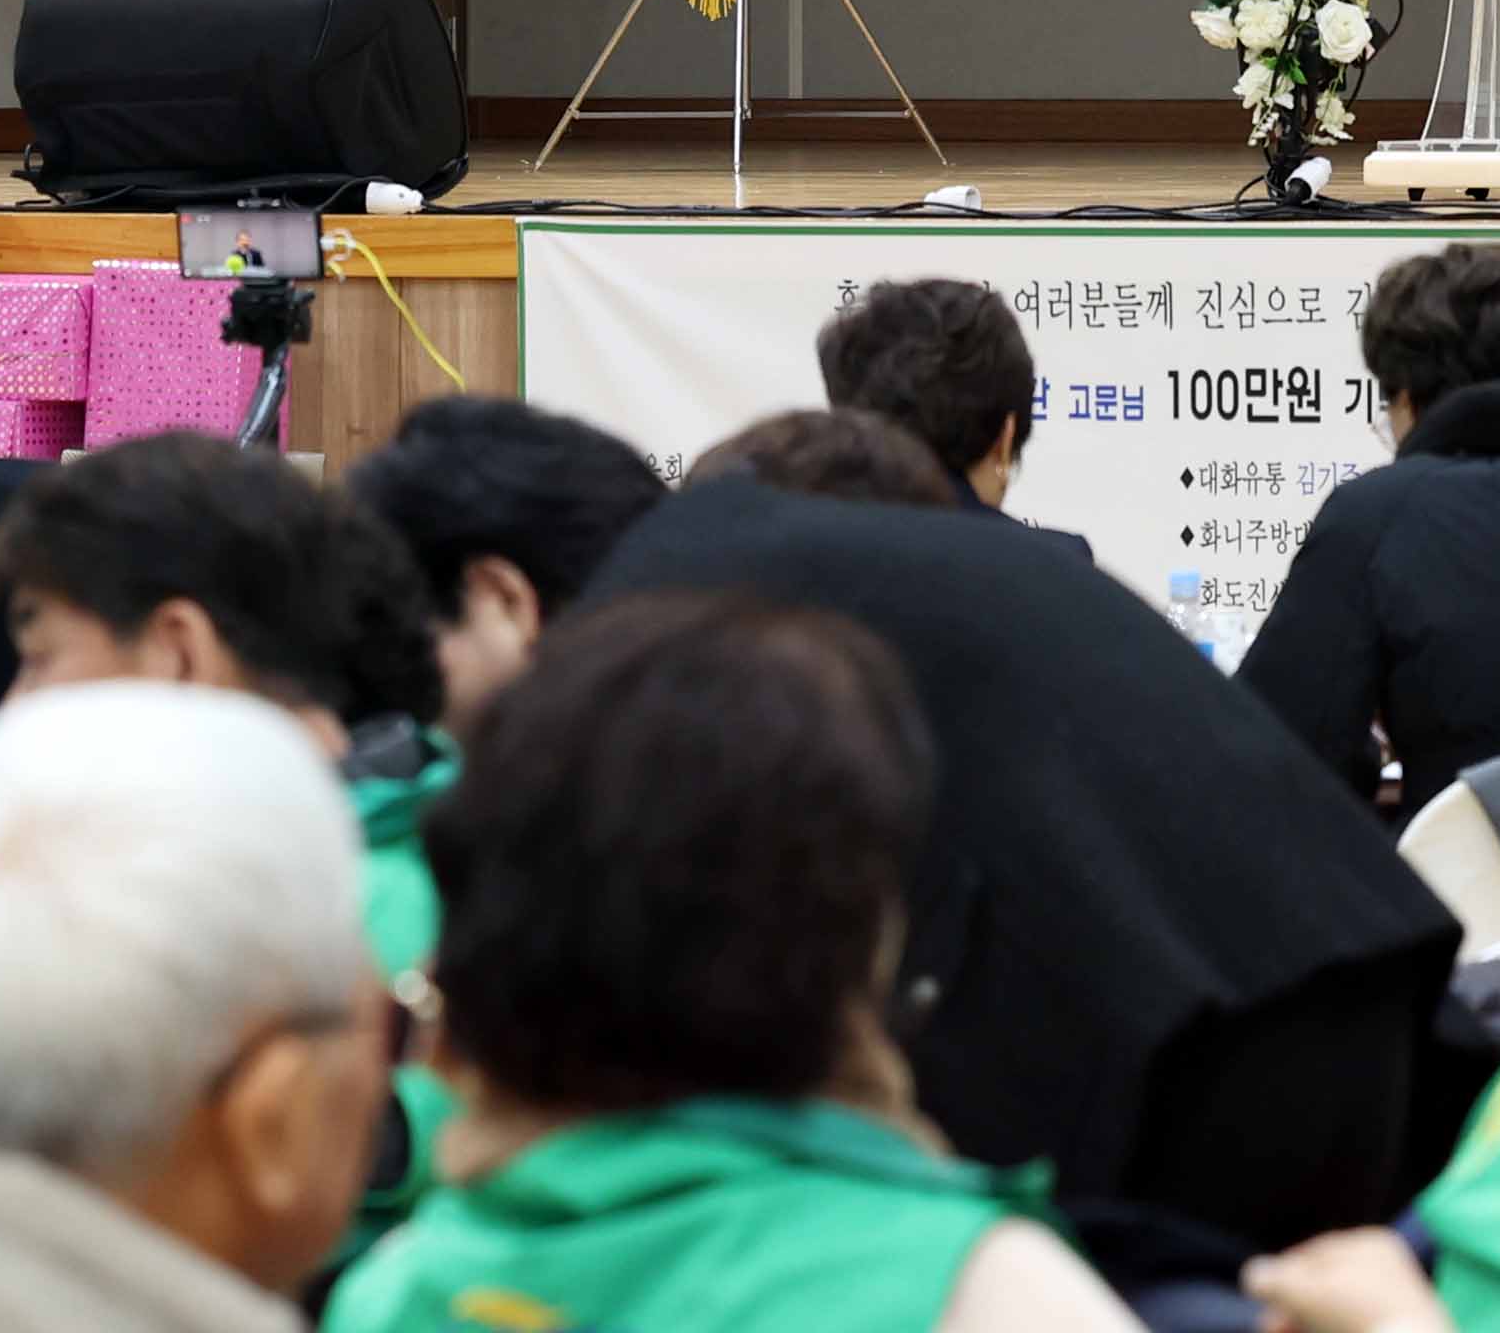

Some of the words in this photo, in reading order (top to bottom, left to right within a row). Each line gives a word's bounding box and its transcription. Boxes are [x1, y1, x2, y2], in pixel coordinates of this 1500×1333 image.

[1014, 280, 1173, 331] 여러분들께
[1196, 281, 1327, 331] 진심으로
[1068, 384, 1144, 422] 고문님
[1167, 366, 1321, 423] 100만원
[1199, 461, 1287, 496] 대화유통
[1201, 578, 1287, 612] 화도진
